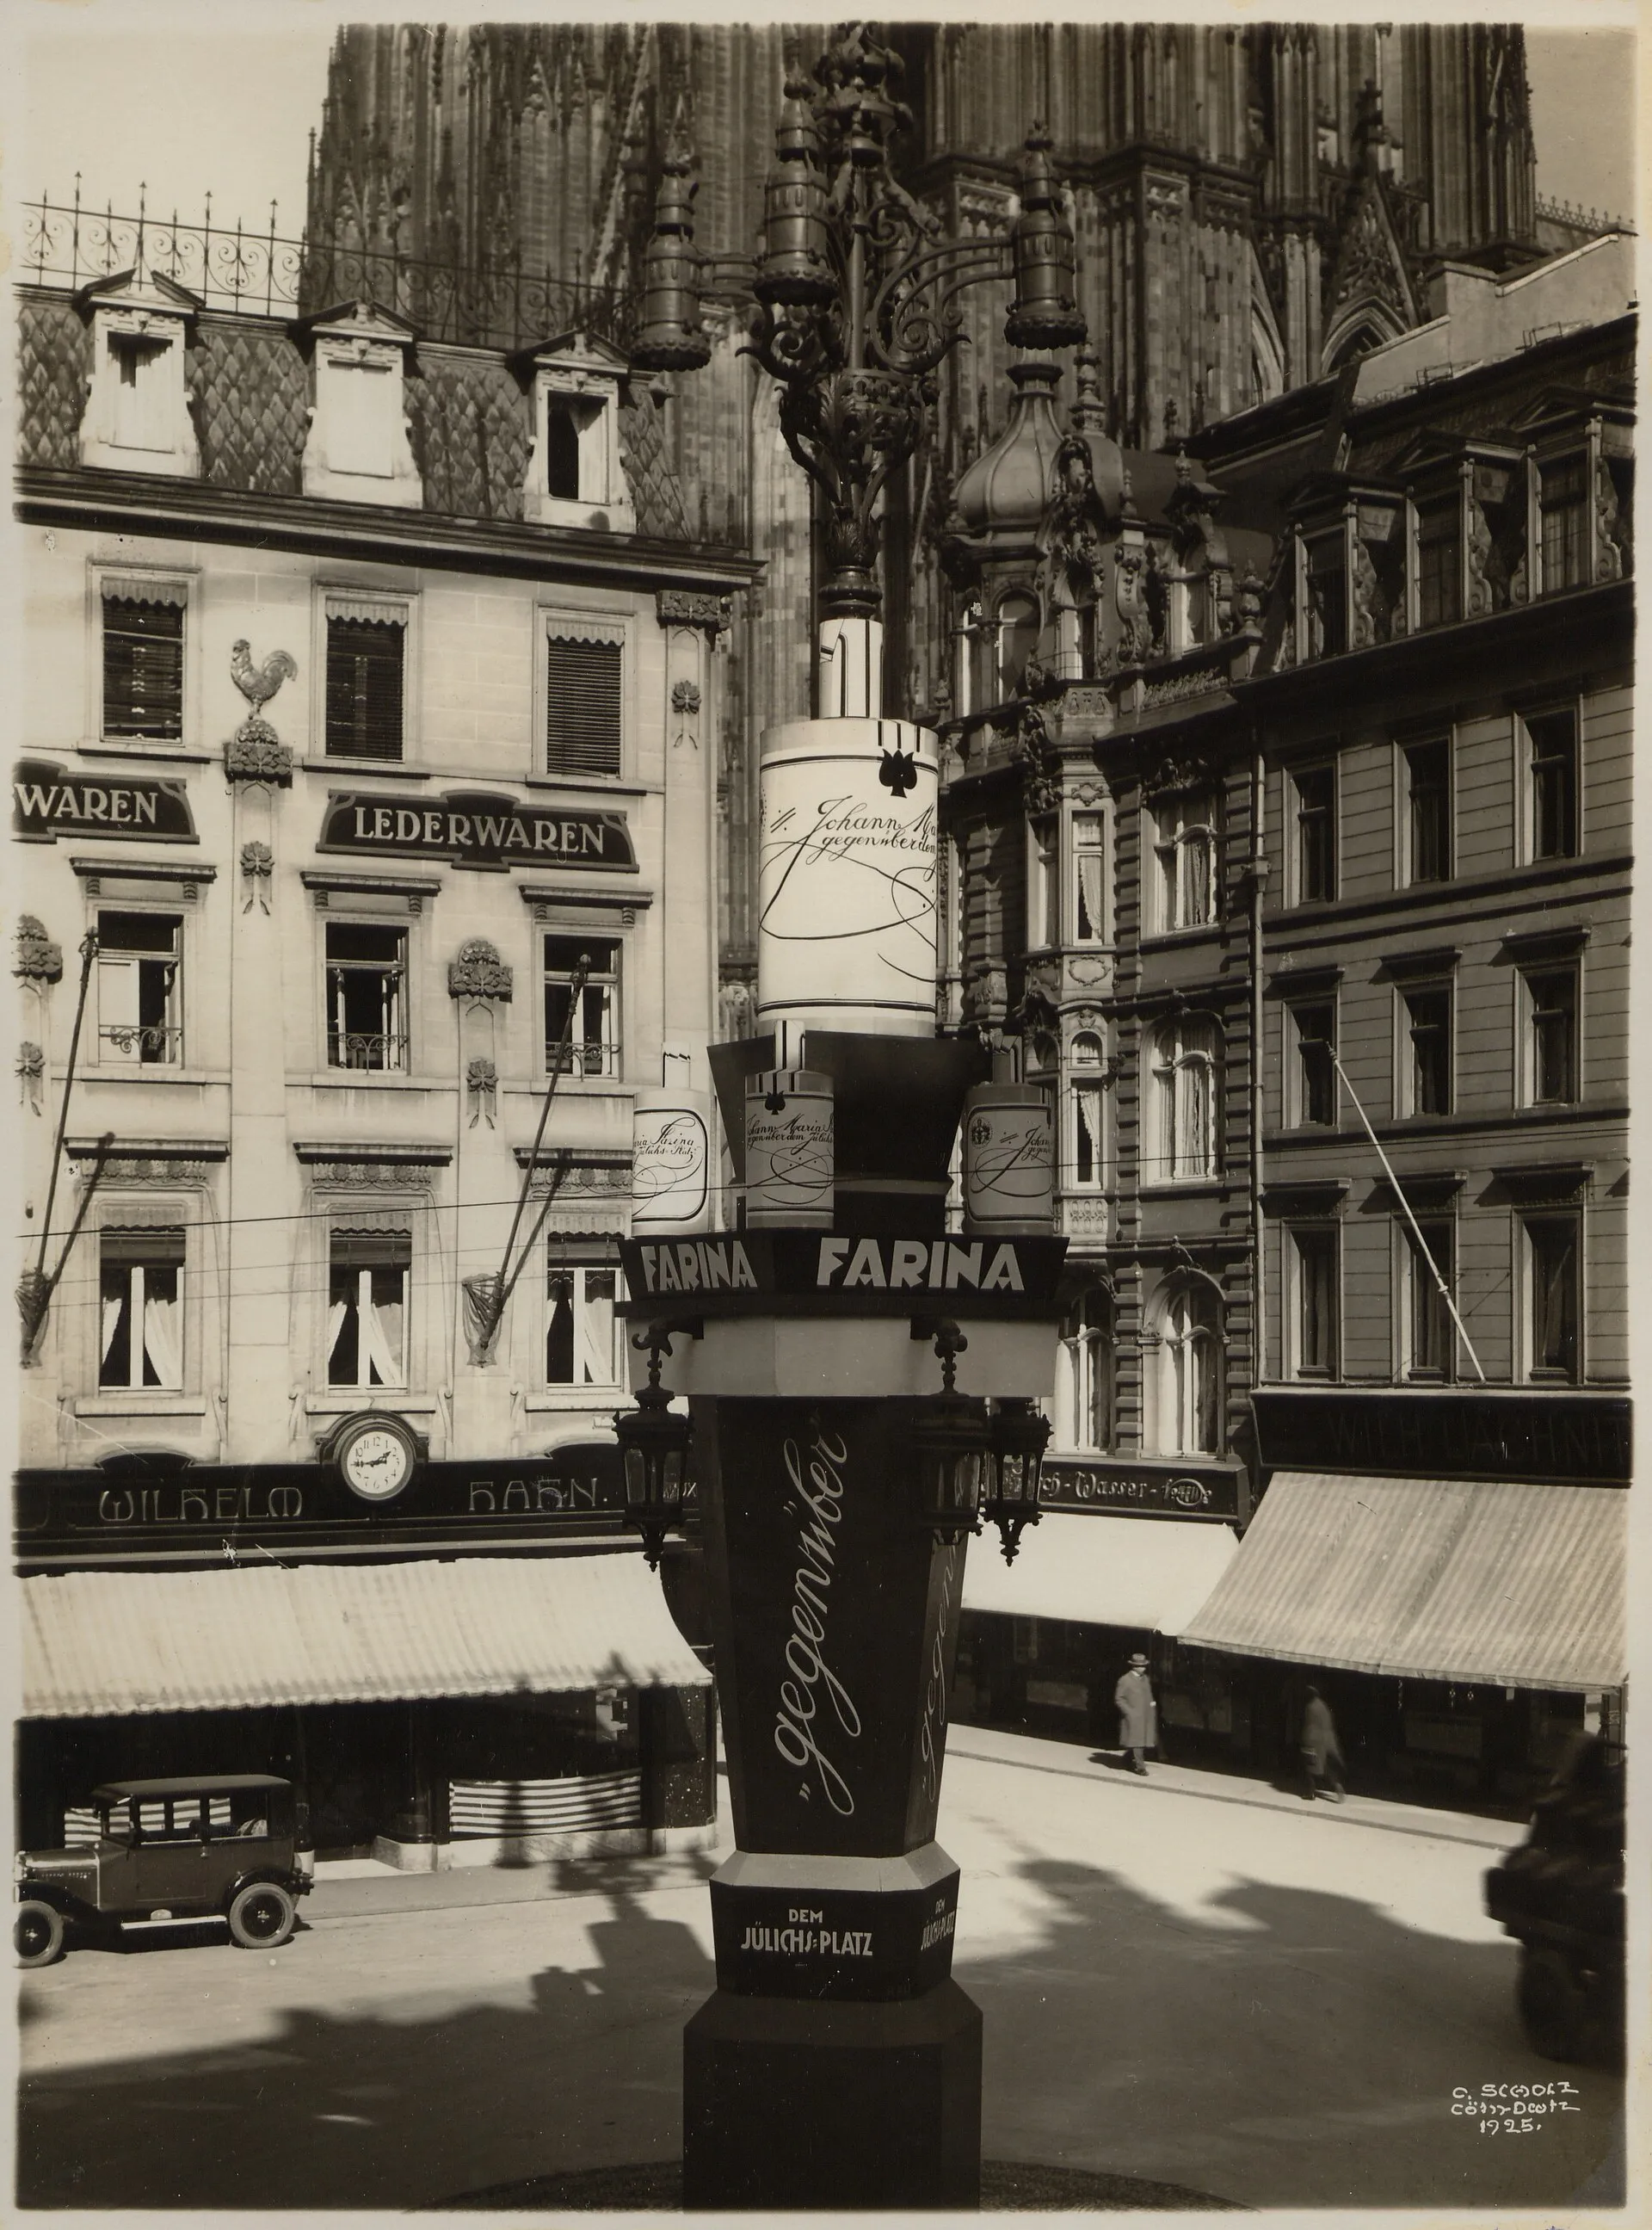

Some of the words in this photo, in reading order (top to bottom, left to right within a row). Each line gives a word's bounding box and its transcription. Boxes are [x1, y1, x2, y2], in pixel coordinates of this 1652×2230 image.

[354, 806, 605, 855] LEDERWAREN
[641, 1240, 758, 1292] FARINA
[817, 1237, 1025, 1291] FARINA
[99, 1486, 302, 1522] WILHELM
[789, 1908, 823, 1924] DEM
